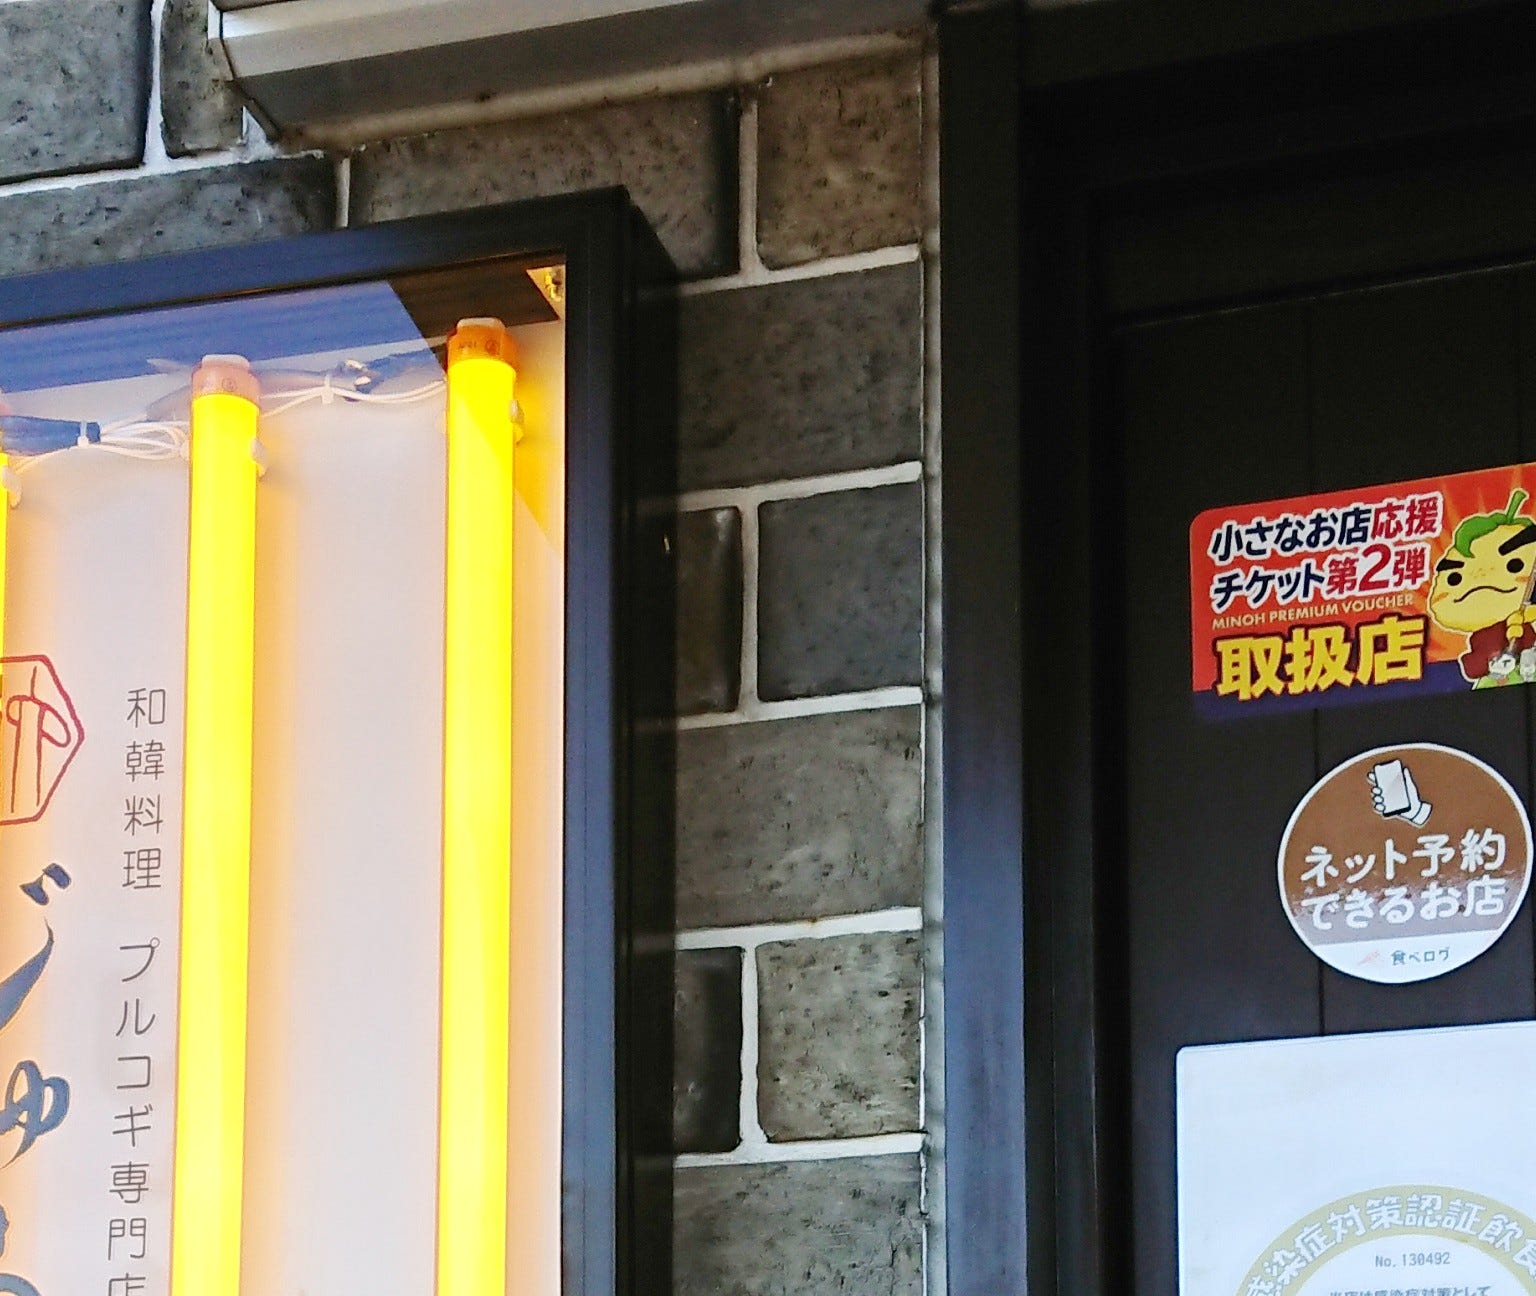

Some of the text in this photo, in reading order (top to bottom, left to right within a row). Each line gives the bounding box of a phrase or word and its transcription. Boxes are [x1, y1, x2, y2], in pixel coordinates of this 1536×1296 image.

[1210, 495, 1441, 562] 小さなお店応援
[1213, 542, 1428, 609] チケット第2弾
[1212, 593, 1415, 631] MINOH PREMIUM VOUCHER
[1215, 615, 1427, 701] 取扱店
[121, 687, 167, 891] 和韓料理
[1299, 826, 1507, 887] ネット予約
[1300, 874, 1507, 931] できるお店
[1390, 945, 1452, 967] 食べログ
